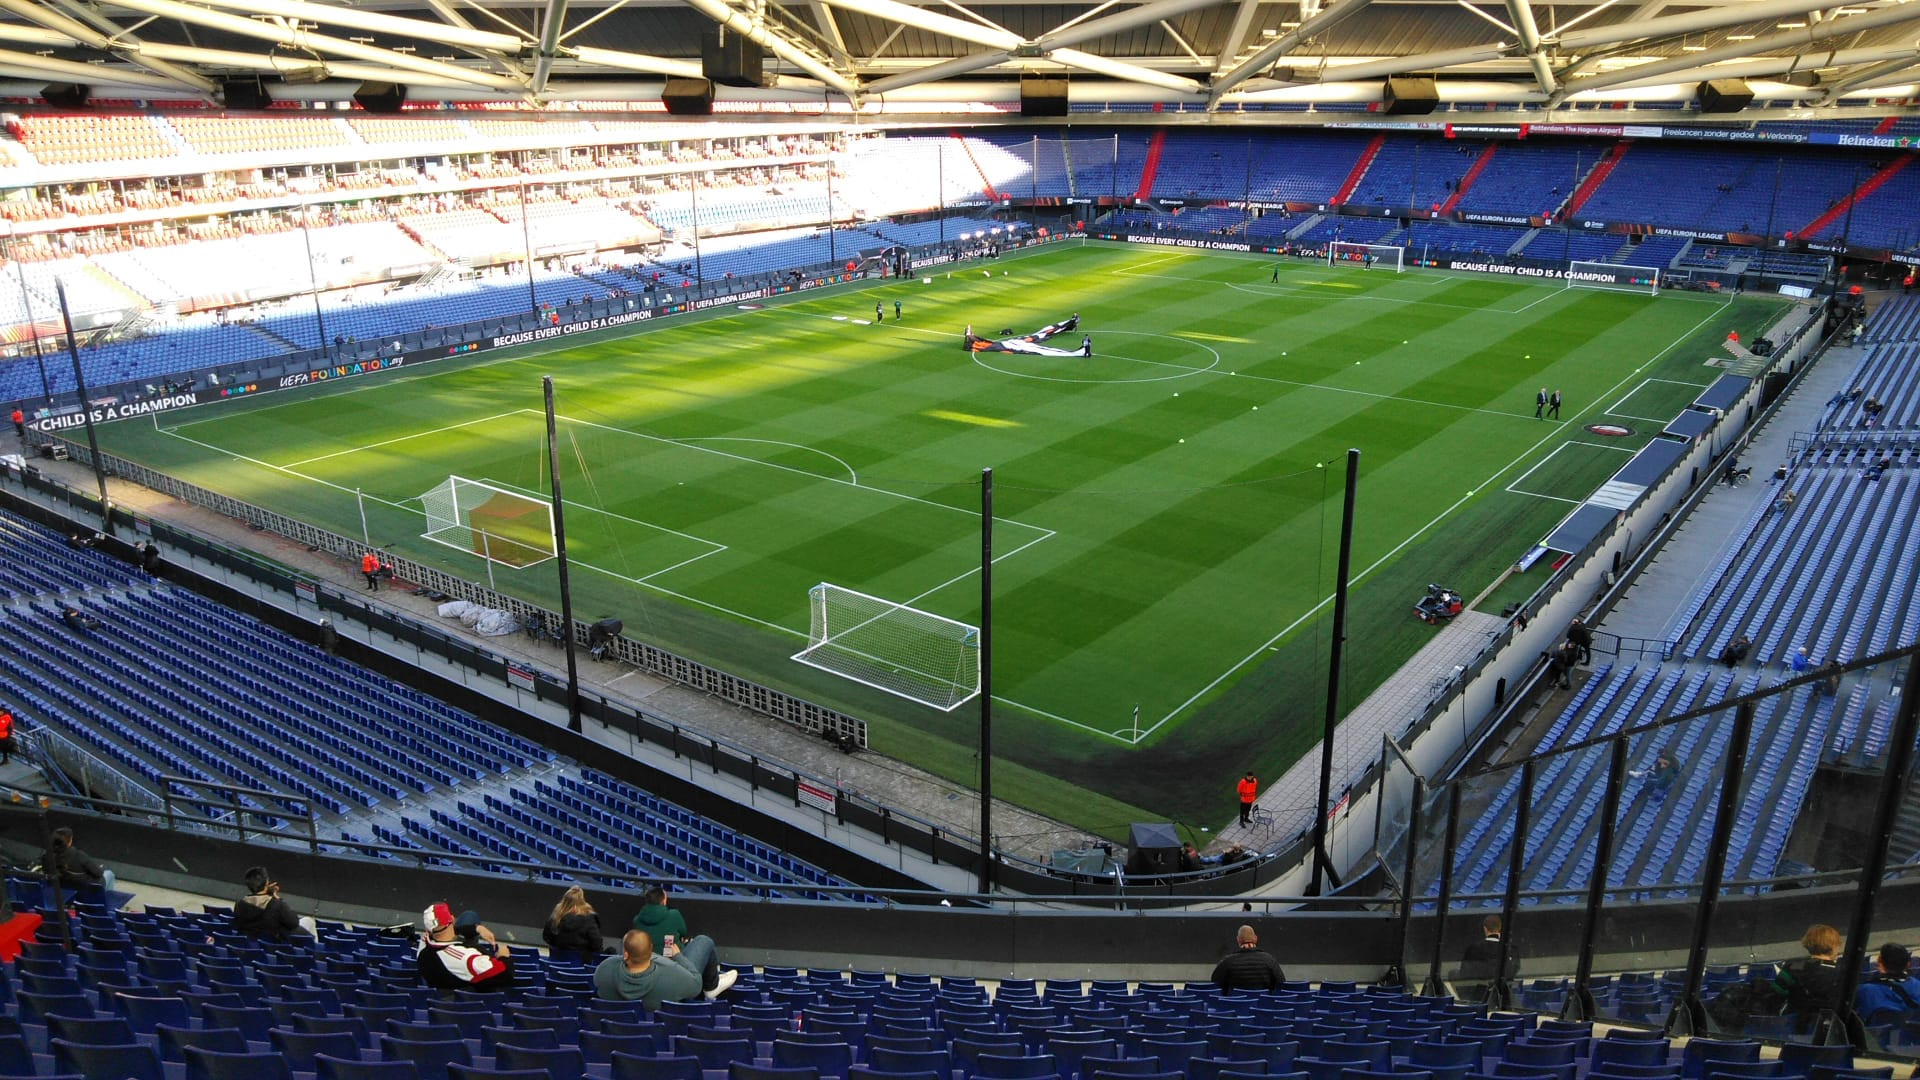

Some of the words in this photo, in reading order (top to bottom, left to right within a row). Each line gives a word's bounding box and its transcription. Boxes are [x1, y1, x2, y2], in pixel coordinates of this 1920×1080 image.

[1664, 128, 1702, 137] Freelancen
[1704, 130, 1729, 138] zonder
[1730, 131, 1755, 140] gedoe
[1838, 134, 1895, 147] Heineken
[1655, 228, 1672, 236] UEFA
[1672, 230, 1698, 238] EUROPA
[1698, 232, 1724, 240] LEAGUE
[1128, 235, 1155, 244] BECAUSE
[1156, 238, 1176, 246] EVERY
[1177, 239, 1197, 248] CHILD
[1212, 242, 1250, 252] CHAMPION
[1450, 261, 1488, 272] BECAUSE
[1488, 264, 1516, 274] EVERY
[1516, 267, 1544, 278] CHILD
[1545, 269, 1554, 278] IS
[1554, 270, 1563, 279] A
[1564, 271, 1616, 283] CHAMPION
[696, 300, 714, 309] UEFA
[714, 295, 738, 306] EUROPA
[738, 290, 762, 301] LEAGUE
[494, 331, 534, 347] BECAUSE
[535, 326, 562, 340] EVERY
[564, 321, 590, 334] CHILD
[591, 320, 598, 329] IS
[600, 318, 607, 328] A
[608, 310, 652, 326] CHAMPION
[280, 374, 309, 387] UEFA
[40, 413, 86, 431] CHILD
[89, 410, 102, 423] IS
[106, 408, 118, 420] A
[120, 393, 197, 416] CHAMPION
